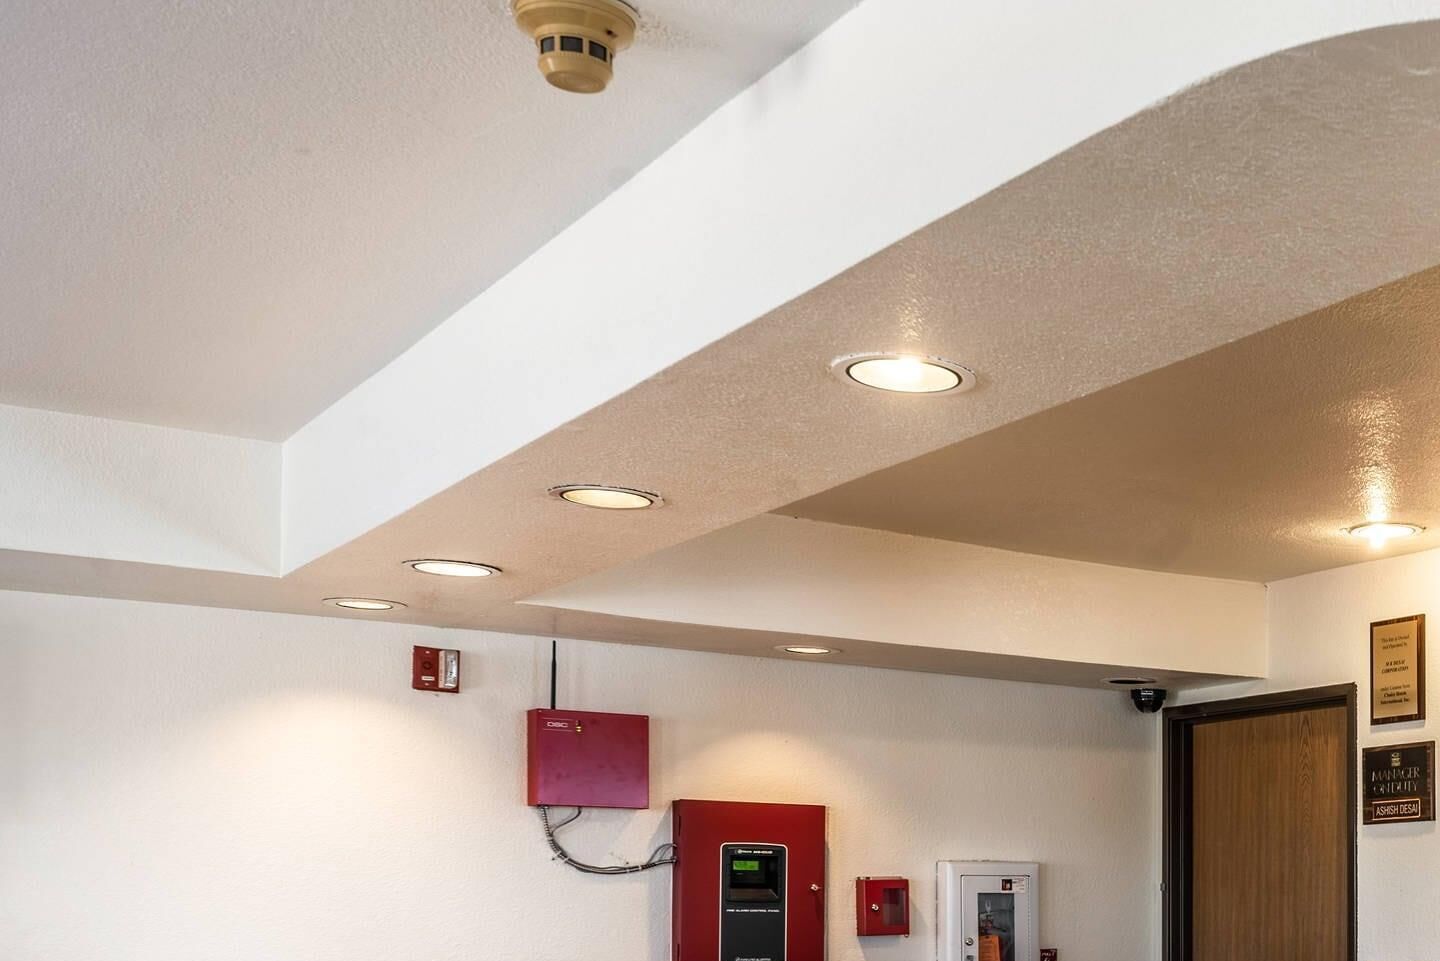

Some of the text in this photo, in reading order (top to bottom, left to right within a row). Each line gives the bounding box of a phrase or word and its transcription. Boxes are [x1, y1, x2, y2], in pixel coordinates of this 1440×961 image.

[1371, 767, 1420, 782] MANAGER
[1373, 780, 1418, 795] ON DUTY
[1376, 803, 1418, 816] ASHISH DESAI
